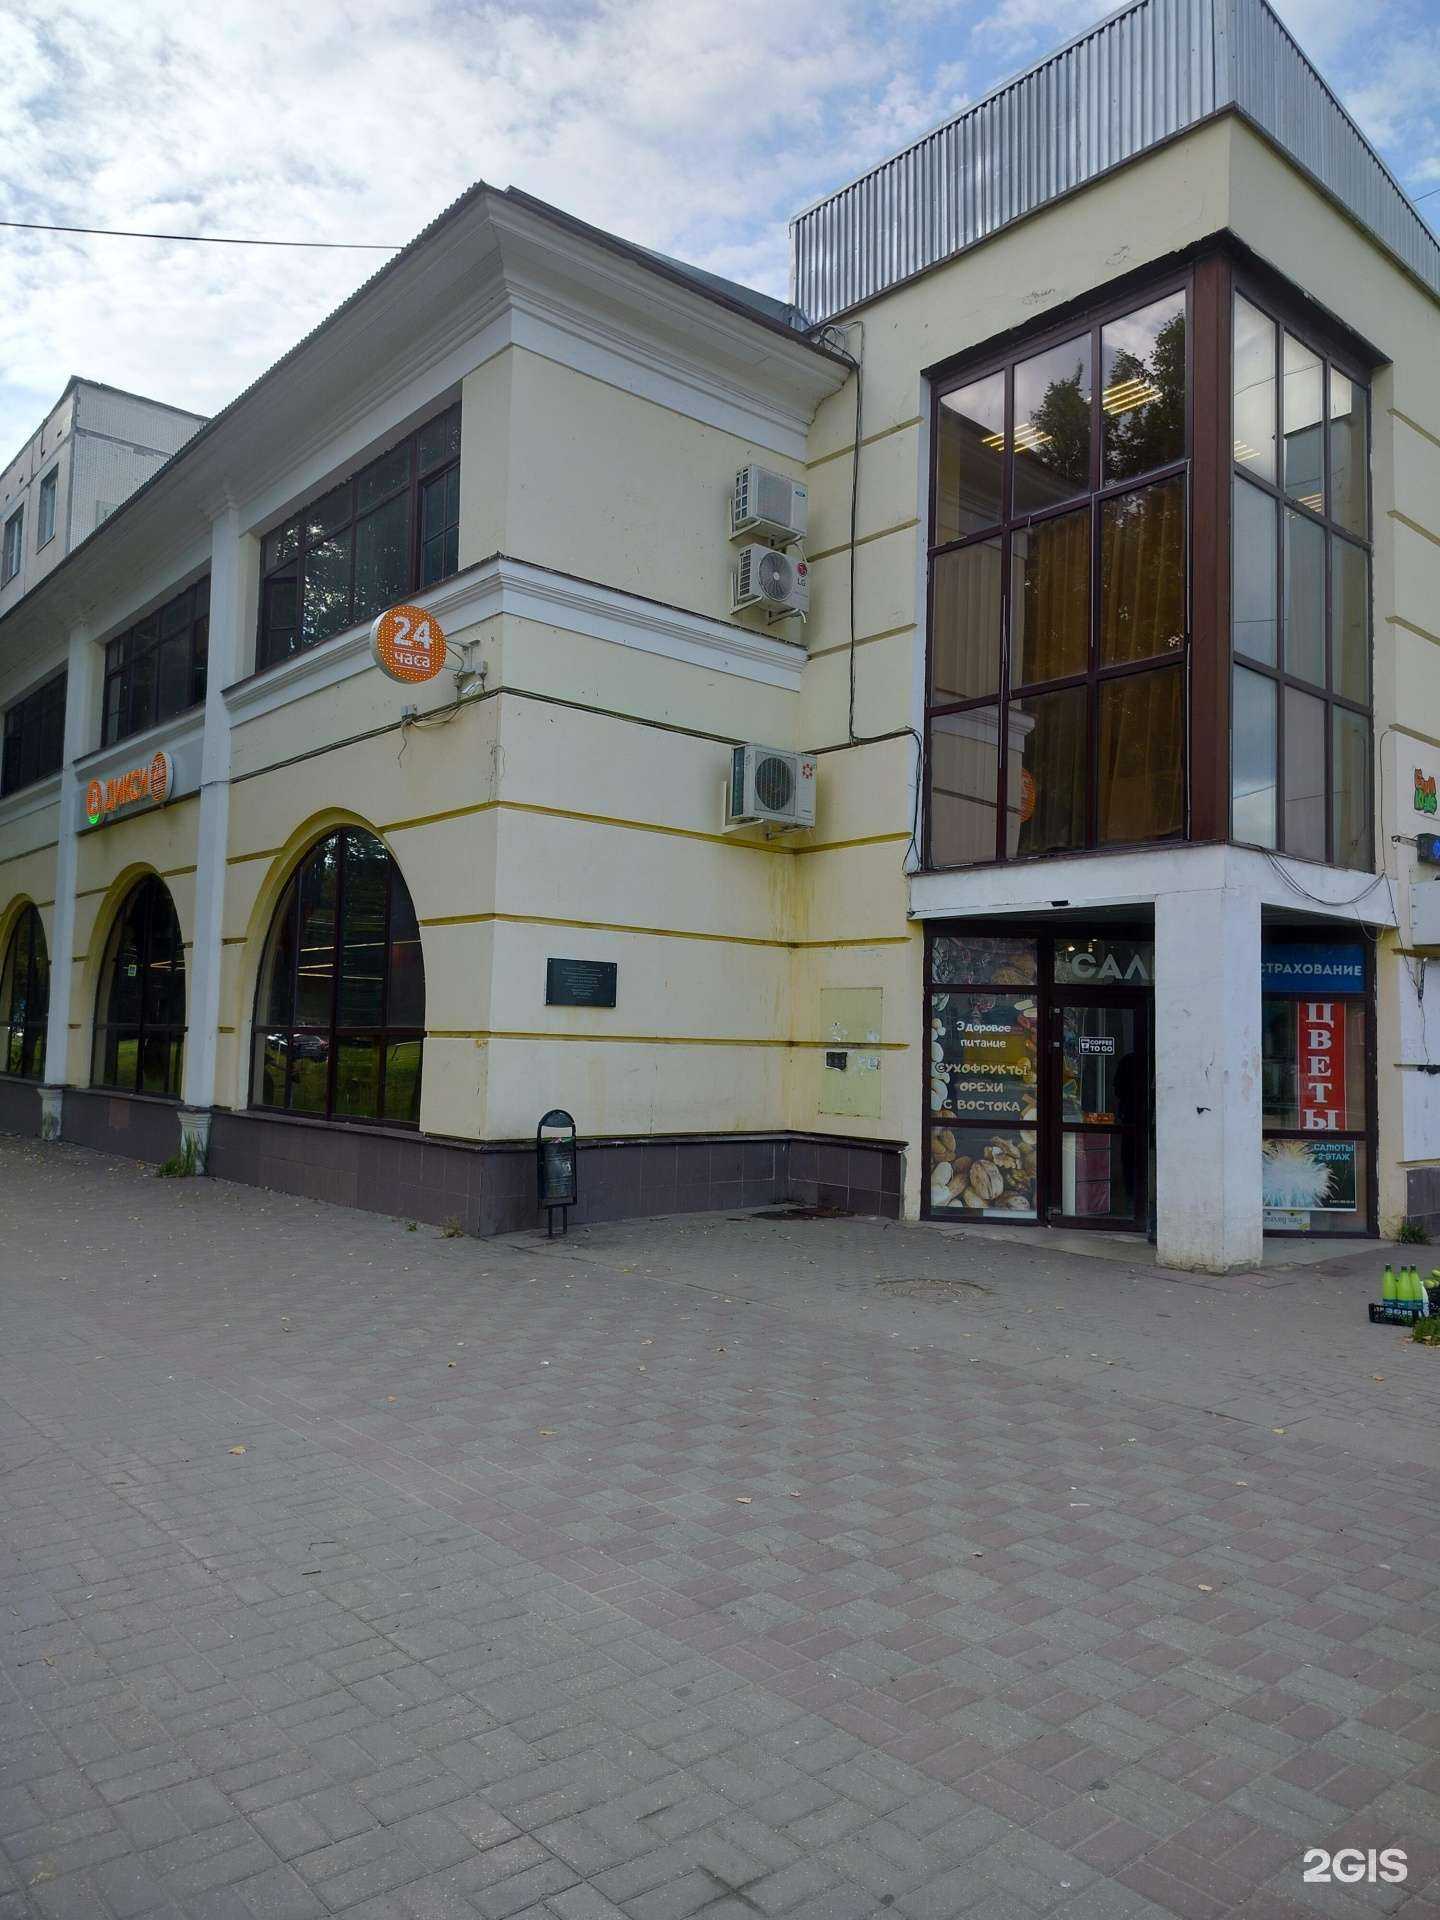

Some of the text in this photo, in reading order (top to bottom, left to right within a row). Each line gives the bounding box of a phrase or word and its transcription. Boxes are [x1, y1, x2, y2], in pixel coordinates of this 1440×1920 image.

[393, 616, 432, 650] 24
[394, 651, 431, 668] часа
[104, 767, 149, 813] ДИКСИ
[956, 1020, 1012, 1034] Здоровое
[960, 1039, 1007, 1049] питание
[1303, 1002, 1340, 1131] ЦВЕТЫ
[959, 1082, 1004, 1094] ОРЕХИ
[957, 1100, 1021, 1113] ВОСТОКА
[1313, 1143, 1354, 1152] САЛЮТЫ
